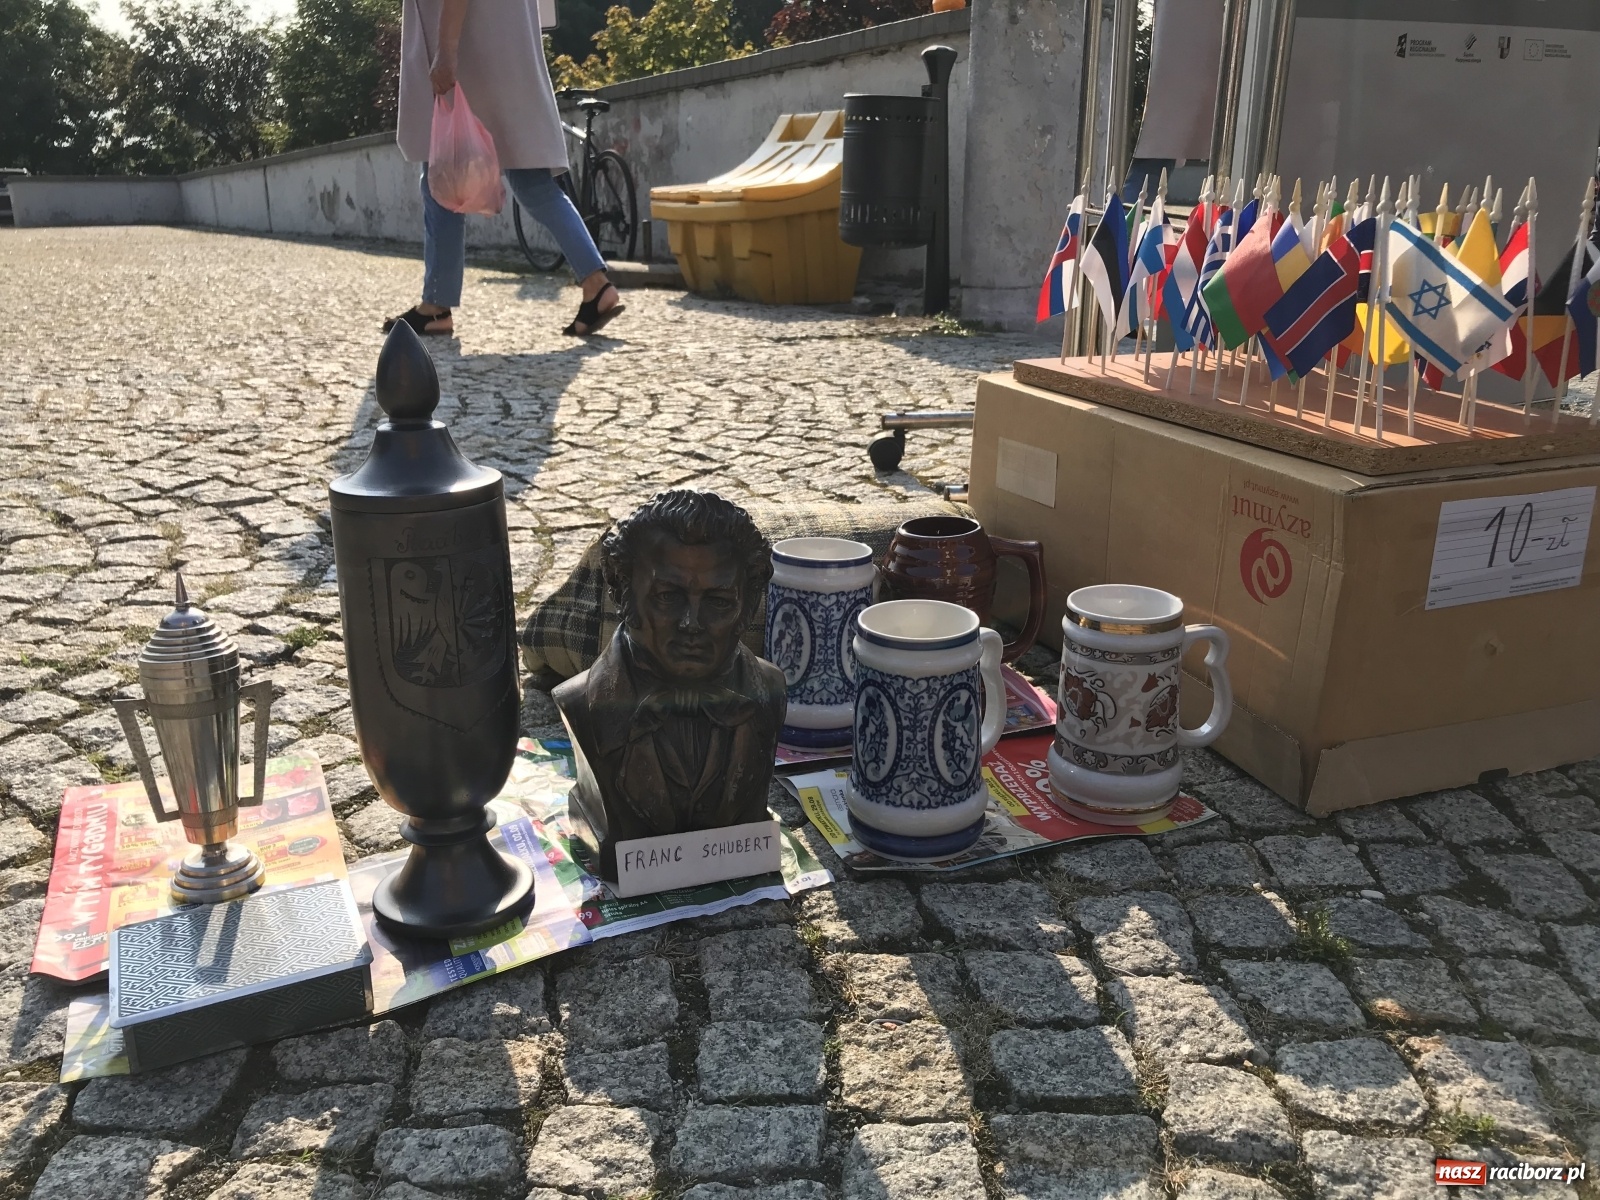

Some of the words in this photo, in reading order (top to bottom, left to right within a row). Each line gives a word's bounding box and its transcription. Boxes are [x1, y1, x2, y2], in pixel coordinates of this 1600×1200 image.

[1231, 495, 1312, 539] azymut
[987, 760, 1052, 822] WYPRZEDAŻ
[623, 845, 683, 872] FRANC
[702, 834, 773, 858] SCHUBERT
[443, 958, 458, 983] TESTED
[451, 956, 468, 980] QUALITY
